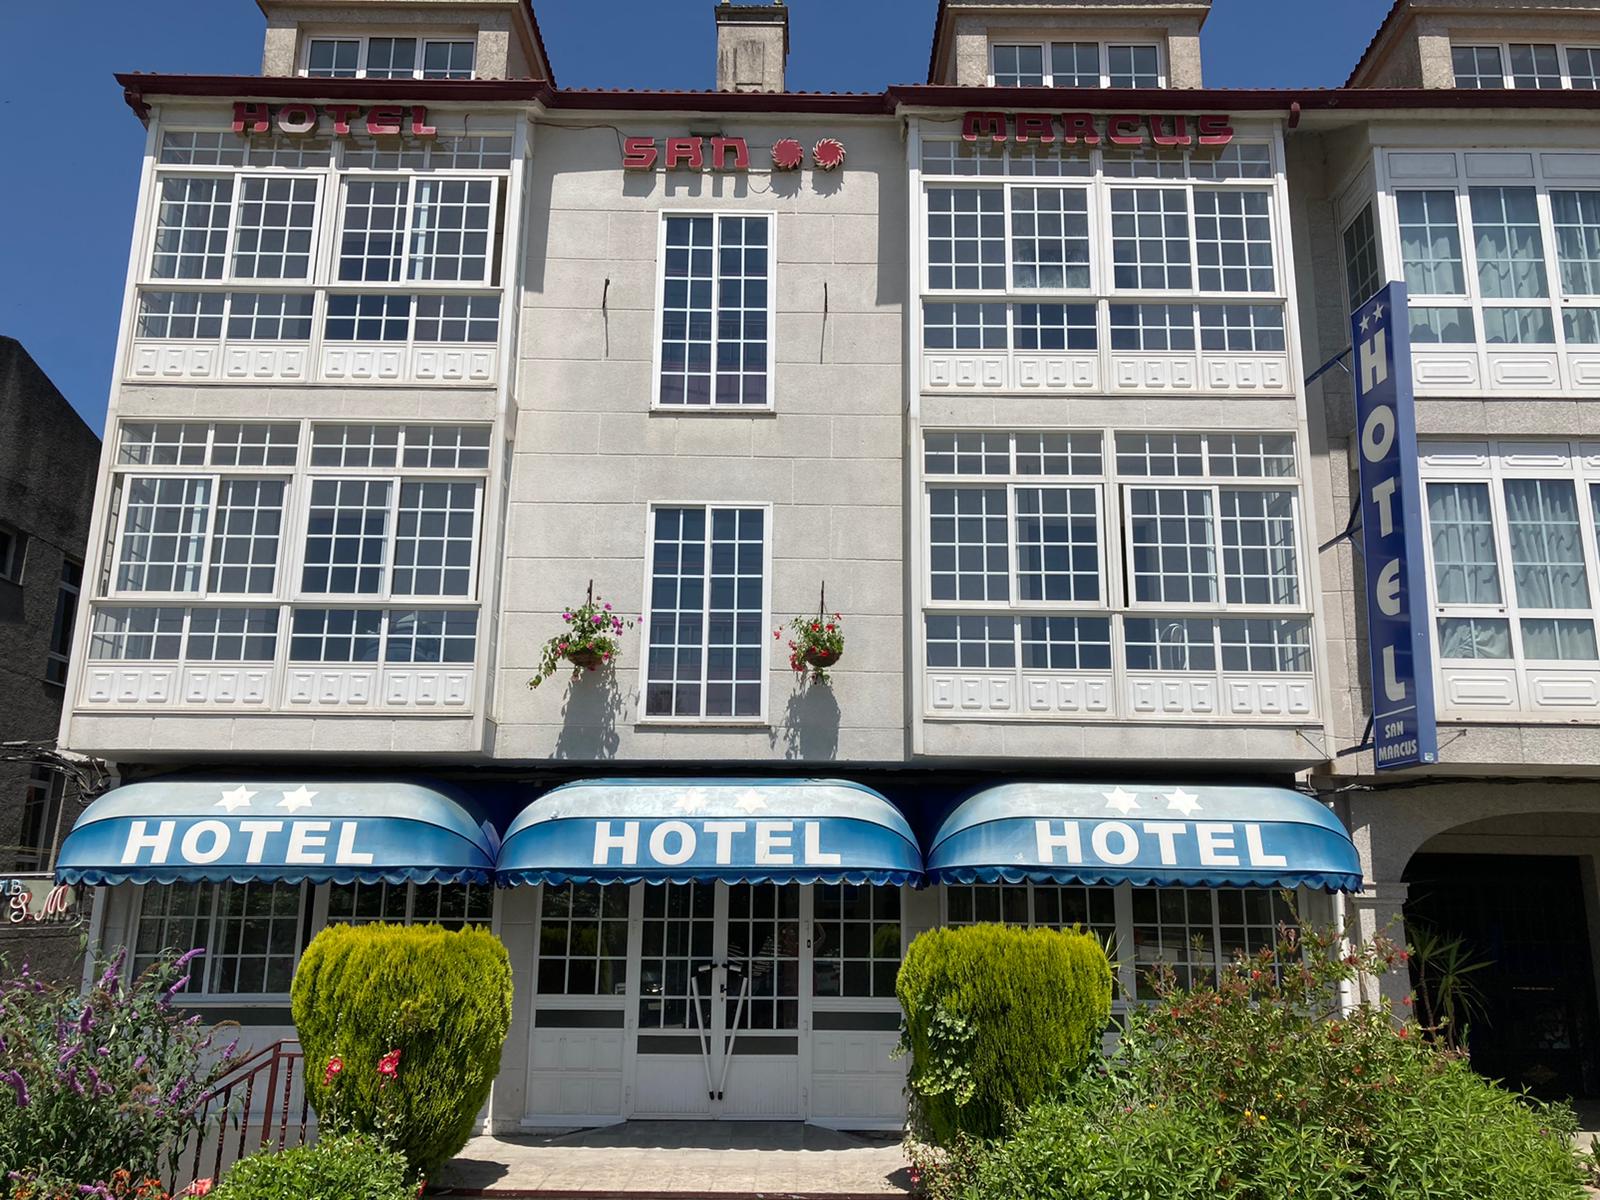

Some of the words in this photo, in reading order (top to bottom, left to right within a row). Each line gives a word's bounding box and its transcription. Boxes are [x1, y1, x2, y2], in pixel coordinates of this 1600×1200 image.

[232, 102, 437, 136] HOTEL
[962, 111, 1234, 145] MARCUS
[623, 137, 748, 169] SAN
[1359, 327, 1407, 702] HOTEL
[1385, 720, 1404, 739] SAN
[1378, 739, 1418, 762] MARCUS
[120, 820, 374, 864] HOTEL
[592, 820, 841, 865] HOTEL
[1035, 820, 1288, 867] HOTEL
